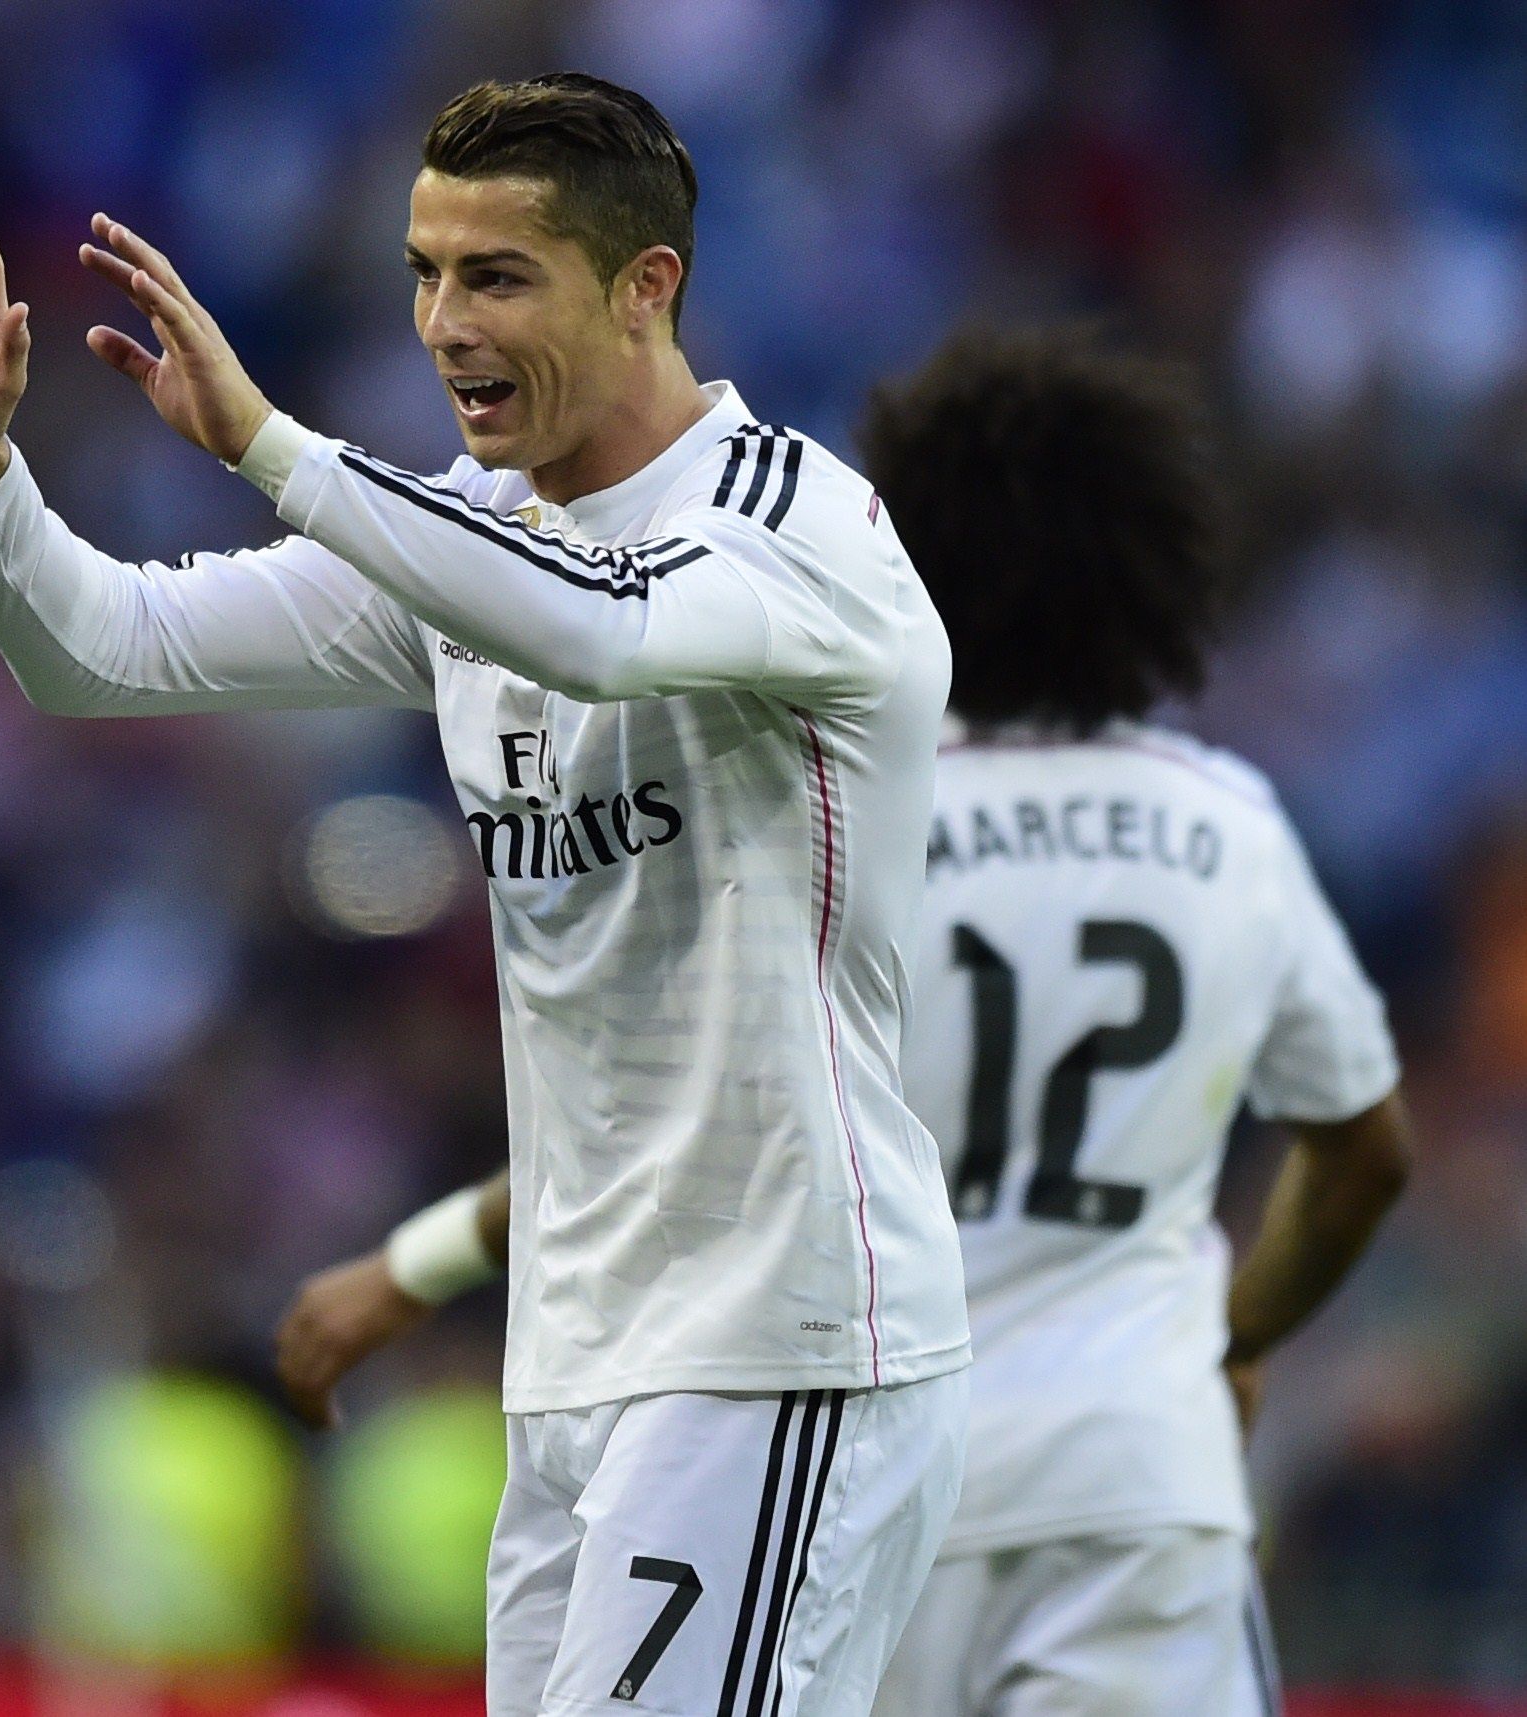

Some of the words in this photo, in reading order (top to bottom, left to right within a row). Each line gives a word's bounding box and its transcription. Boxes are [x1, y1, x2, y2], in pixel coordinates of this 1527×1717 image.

[467, 781, 682, 880] mirates
[950, 918, 1184, 1230] 12
[799, 1320, 842, 1333] adizero
[610, 1556, 704, 1700] 7
